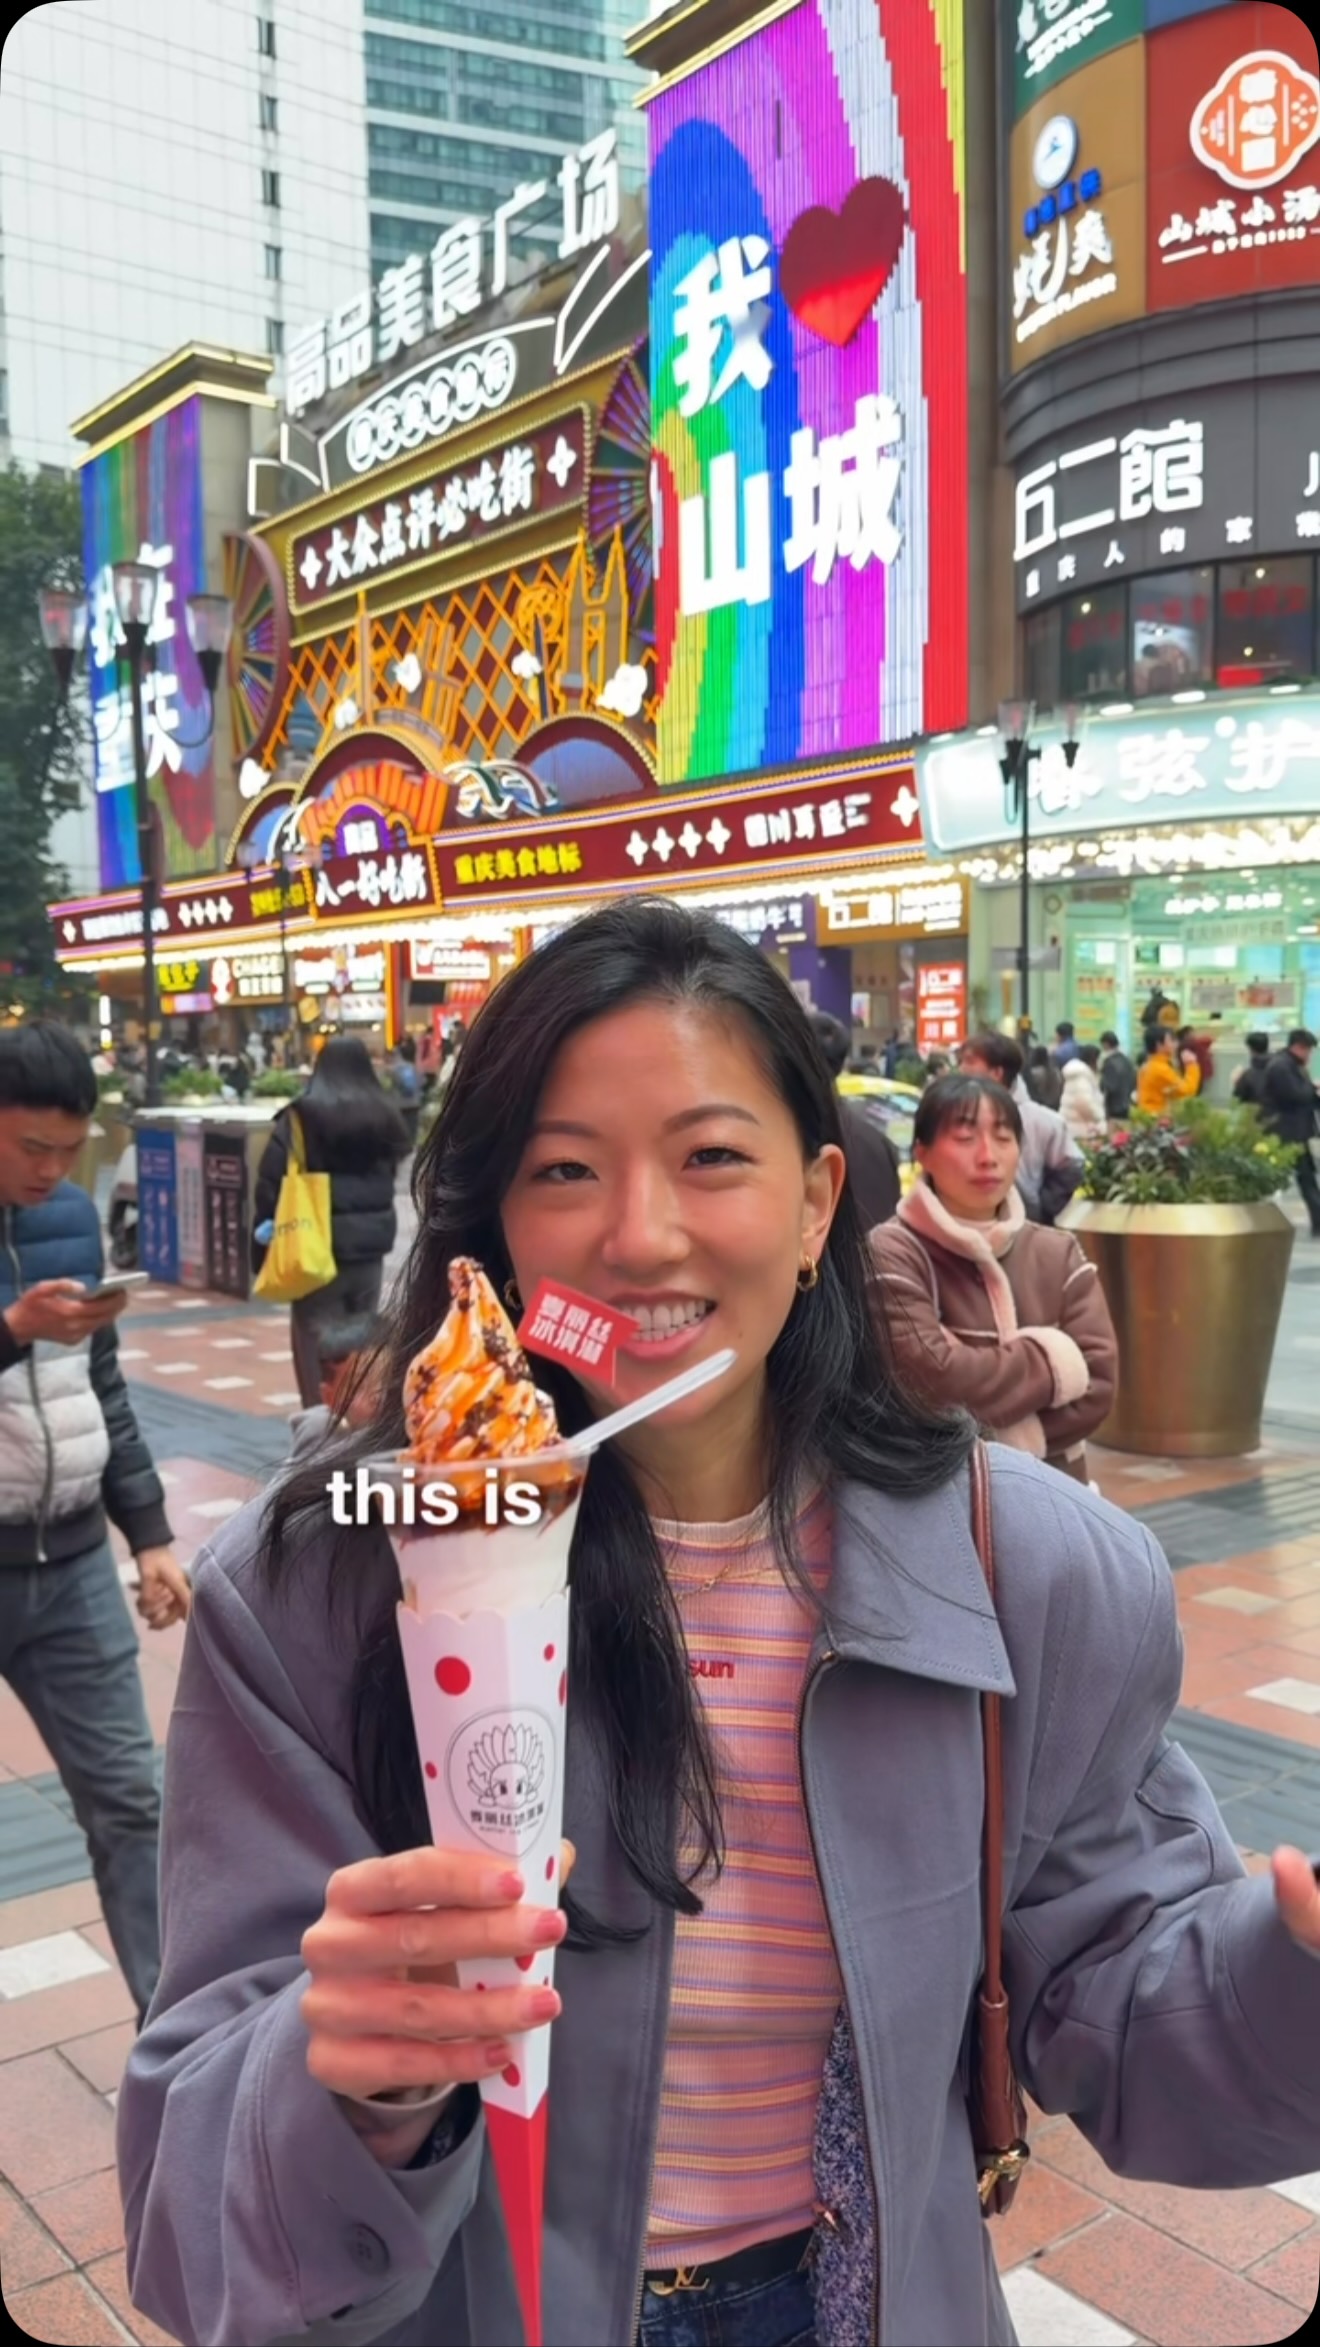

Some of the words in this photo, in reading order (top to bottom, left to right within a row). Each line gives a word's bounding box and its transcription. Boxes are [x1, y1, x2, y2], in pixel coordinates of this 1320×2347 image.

[672, 235, 773, 418] 我
[325, 446, 538, 587] 大众点评必吃街
[679, 394, 905, 618] 山城
[454, 842, 583, 885] 重庆美食地标
